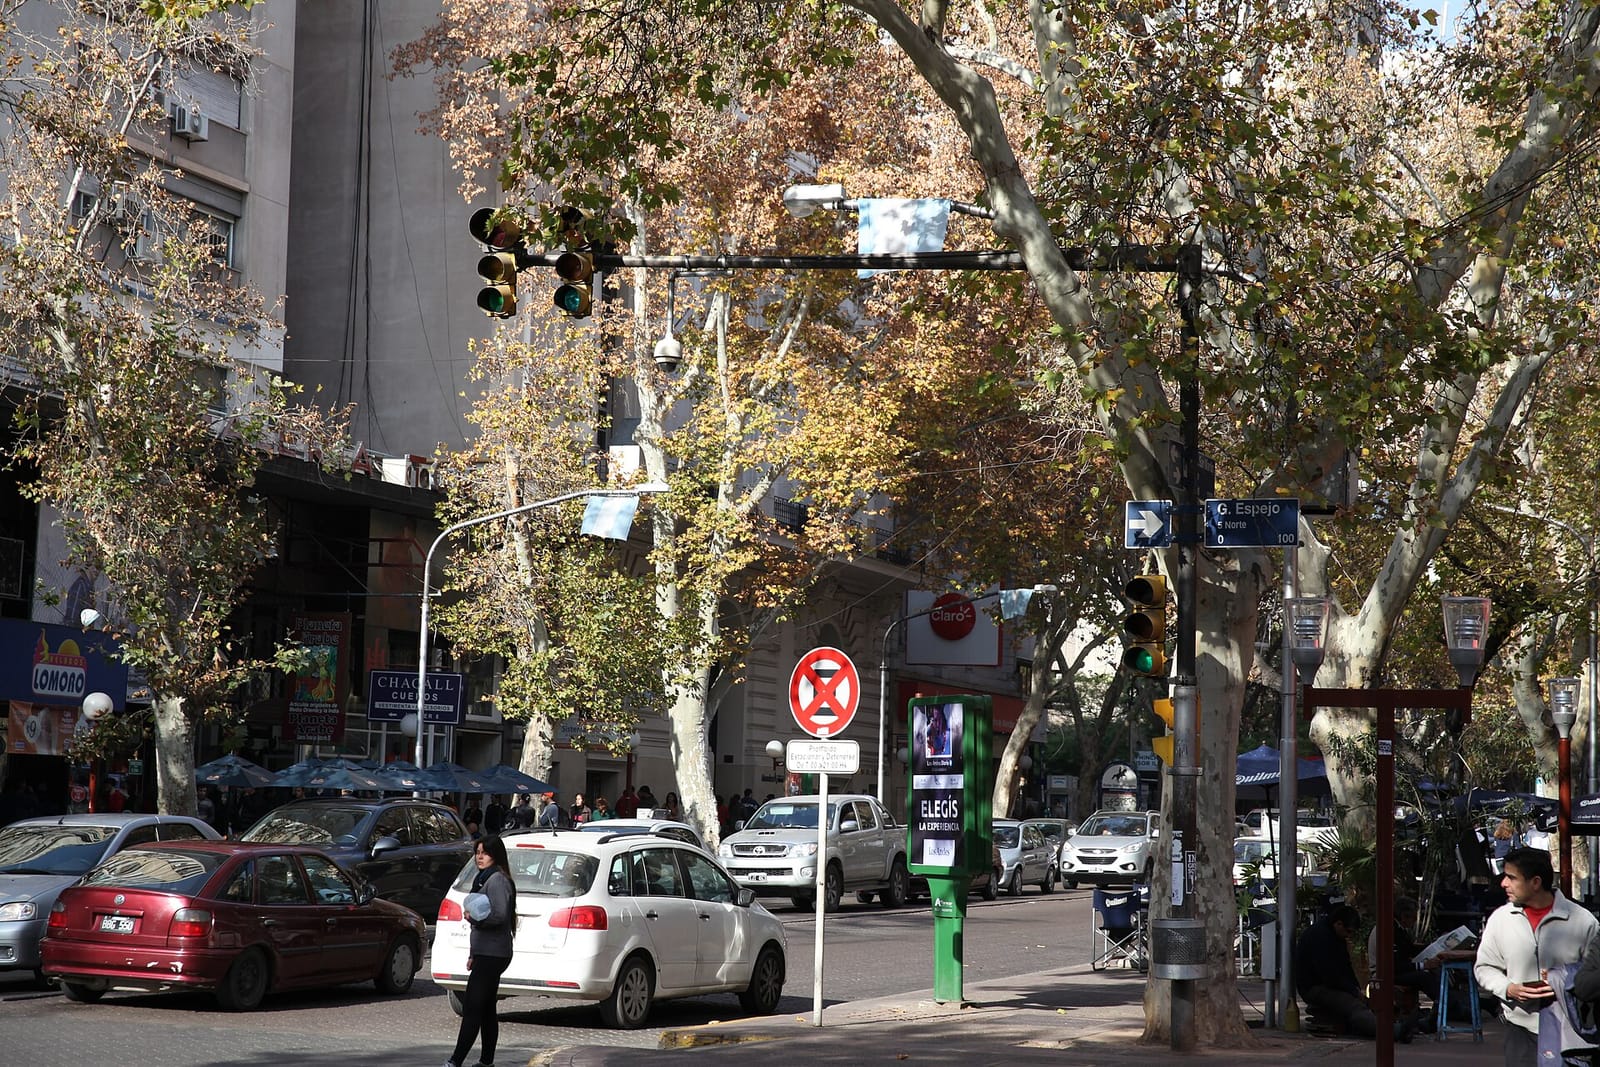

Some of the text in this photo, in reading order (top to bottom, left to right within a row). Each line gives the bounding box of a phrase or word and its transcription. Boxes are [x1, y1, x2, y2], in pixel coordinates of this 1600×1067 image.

[1217, 502, 1280, 517] G. Espejo
[1217, 521, 1247, 529] 5 Norte
[1217, 534, 1224, 544] 0
[1278, 533, 1295, 544] 100
[931, 610, 965, 622] Claro
[391, 691, 438, 702] CUEOS
[288, 713, 338, 725] Planeta
[1235, 771, 1280, 785] Quilme
[921, 794, 958, 818] ELEGÍS
[919, 821, 960, 831] LA EXPERIENCIA
